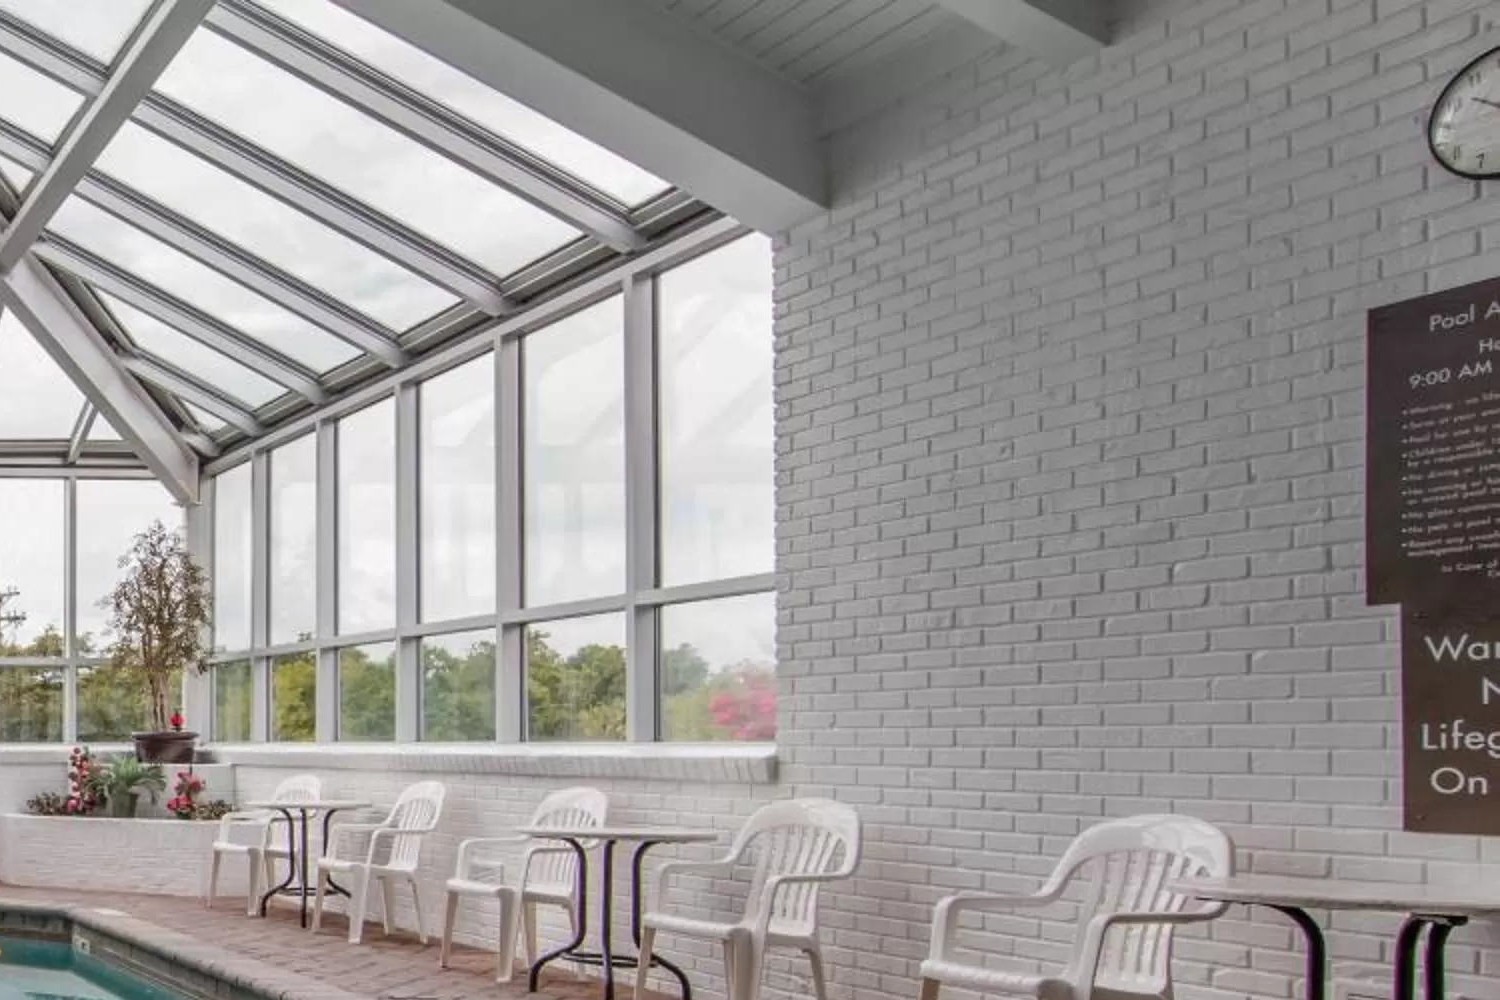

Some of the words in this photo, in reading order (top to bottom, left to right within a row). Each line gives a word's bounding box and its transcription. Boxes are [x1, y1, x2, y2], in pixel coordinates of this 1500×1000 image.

[1429, 303, 1475, 332] Pool
[1409, 367, 1451, 389] 9:00
[1457, 359, 1493, 380] AM
[1430, 766, 1488, 795] On
